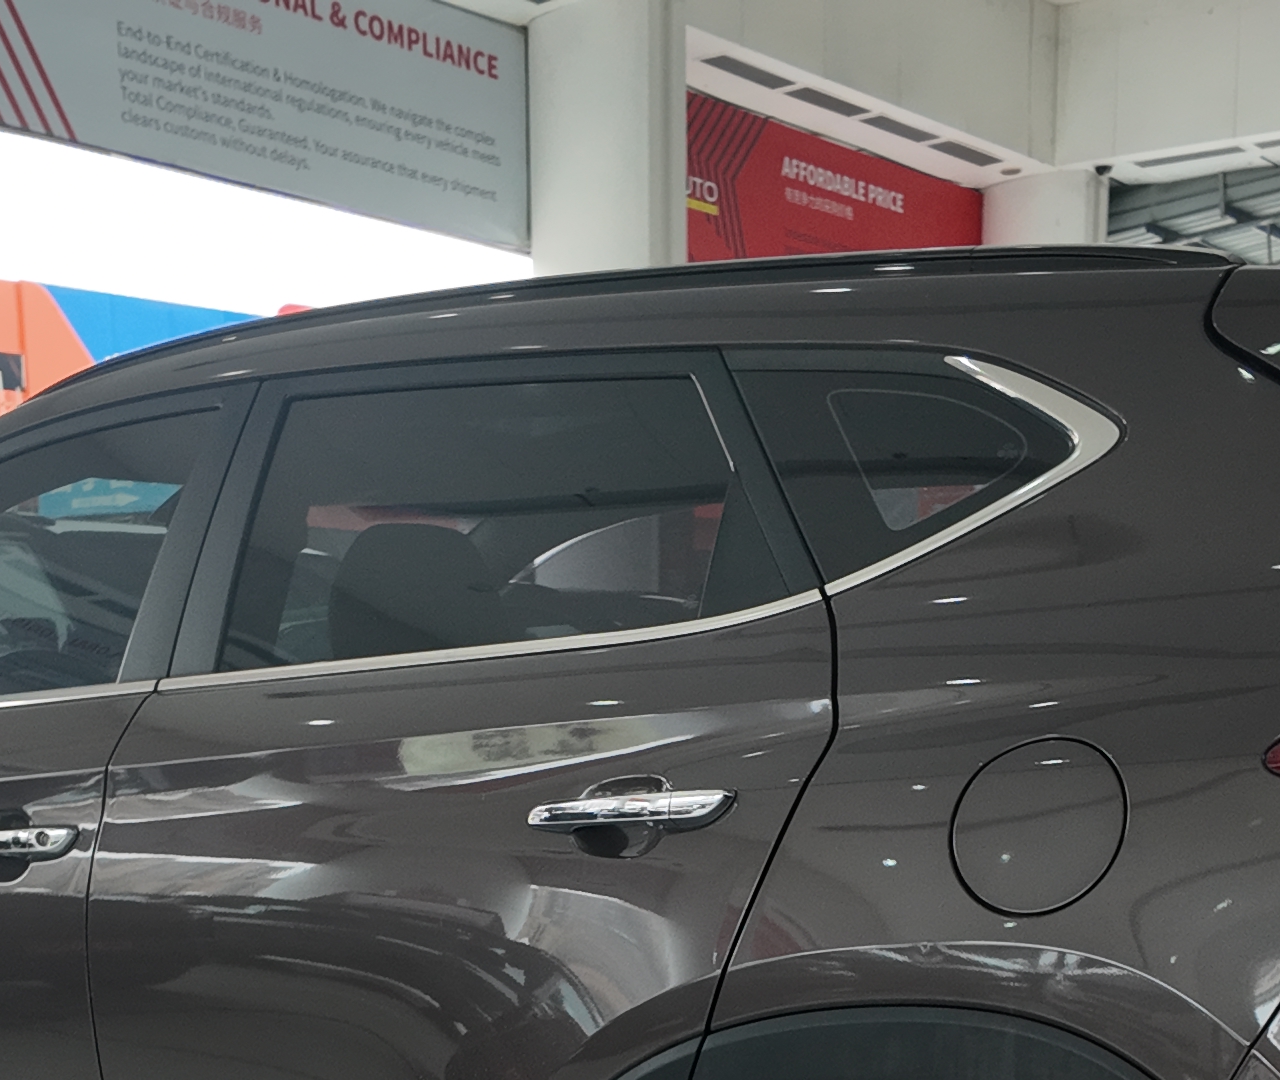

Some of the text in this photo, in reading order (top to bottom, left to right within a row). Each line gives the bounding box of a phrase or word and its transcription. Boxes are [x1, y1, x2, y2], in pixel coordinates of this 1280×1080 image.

[329, 1, 348, 30] &
[353, 10, 499, 80] COMPLIANCE
[117, 20, 191, 56] End-to-End
[194, 43, 270, 78] Certification
[370, 97, 387, 115] We
[389, 105, 434, 129] navigate
[435, 117, 453, 134] the
[454, 125, 496, 147] complex
[117, 41, 501, 167] landscape of international regulations, ensuring every vehicle meets
[118, 68, 275, 121] your market's standards.
[120, 107, 311, 172] clears customs without delays.
[120, 85, 497, 202] Total Compliance, Guaranteed. Your assurance that every shipment
[781, 156, 866, 202] AFFORDABLE
[868, 184, 905, 214] PRICE
